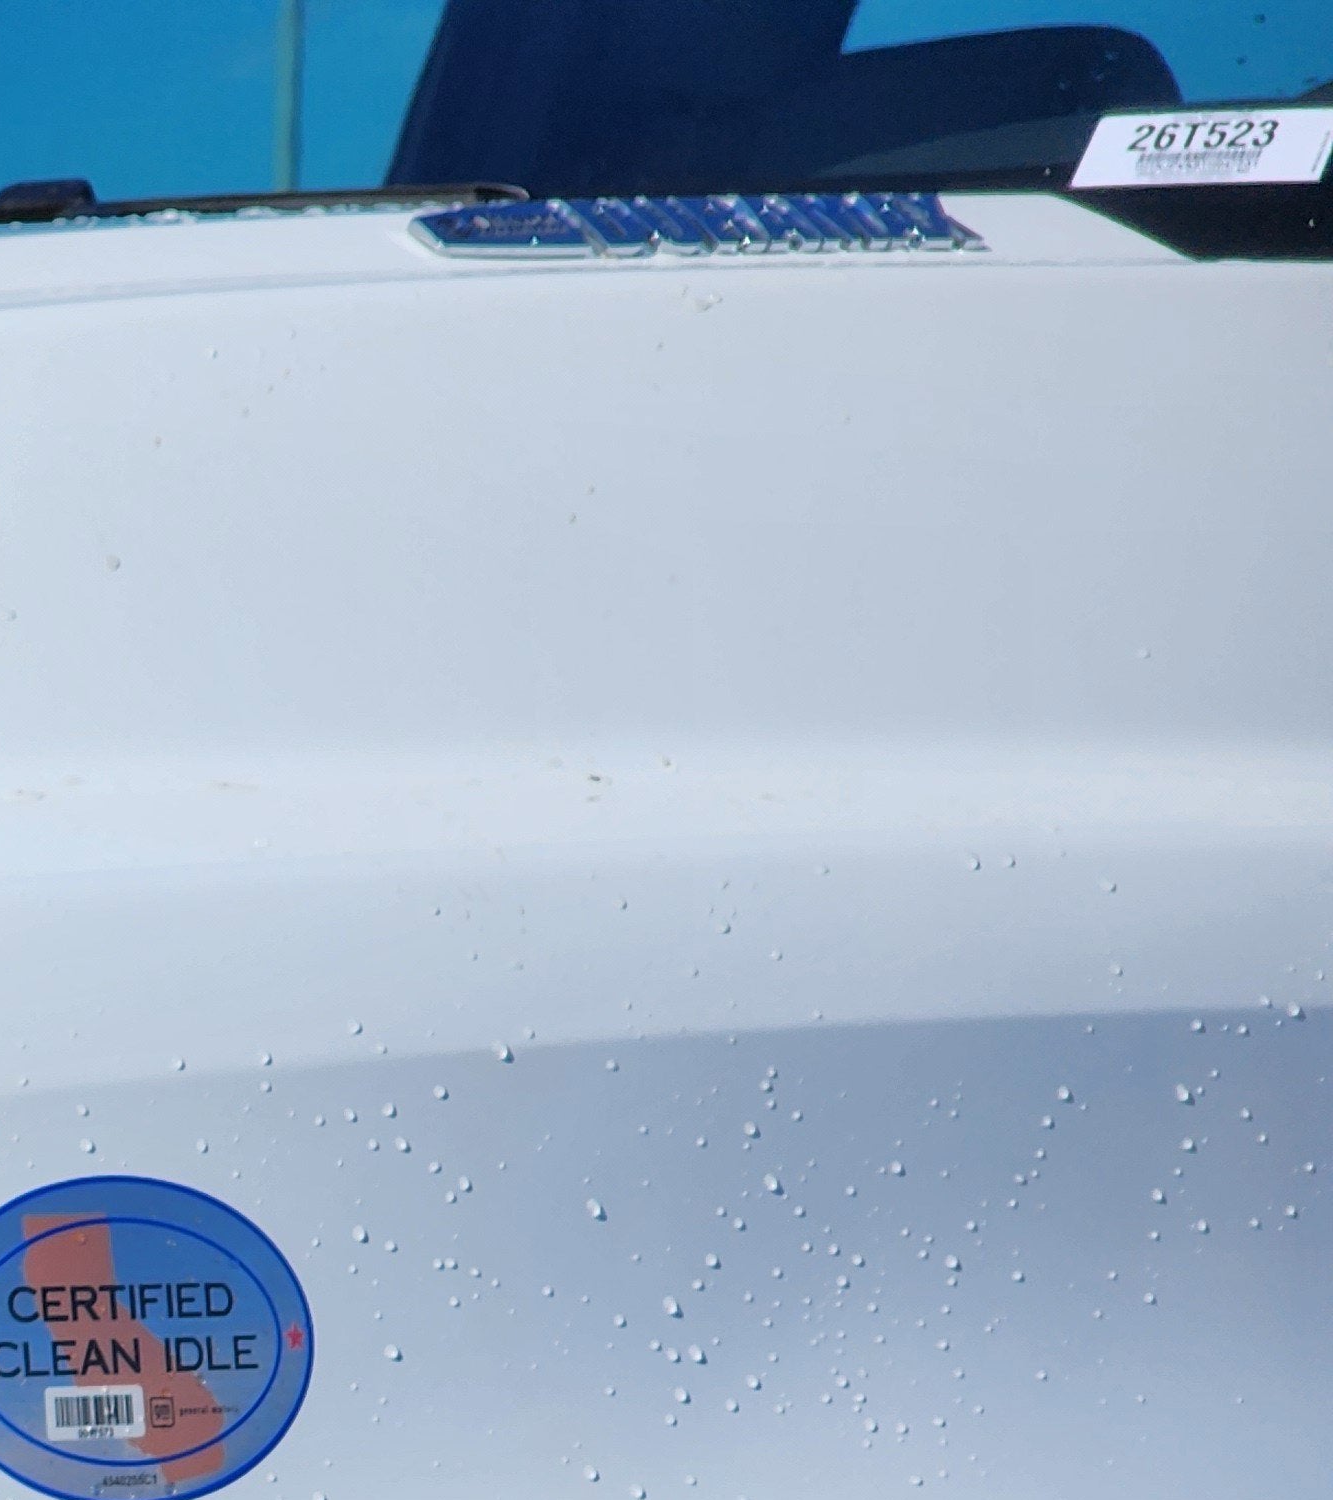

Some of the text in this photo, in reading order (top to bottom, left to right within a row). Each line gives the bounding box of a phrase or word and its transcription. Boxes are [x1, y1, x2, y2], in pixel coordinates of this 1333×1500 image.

[1127, 120, 1279, 152] 26T523
[7, 1281, 234, 1323] CERTIFIED
[164, 1334, 259, 1373] IDLE
